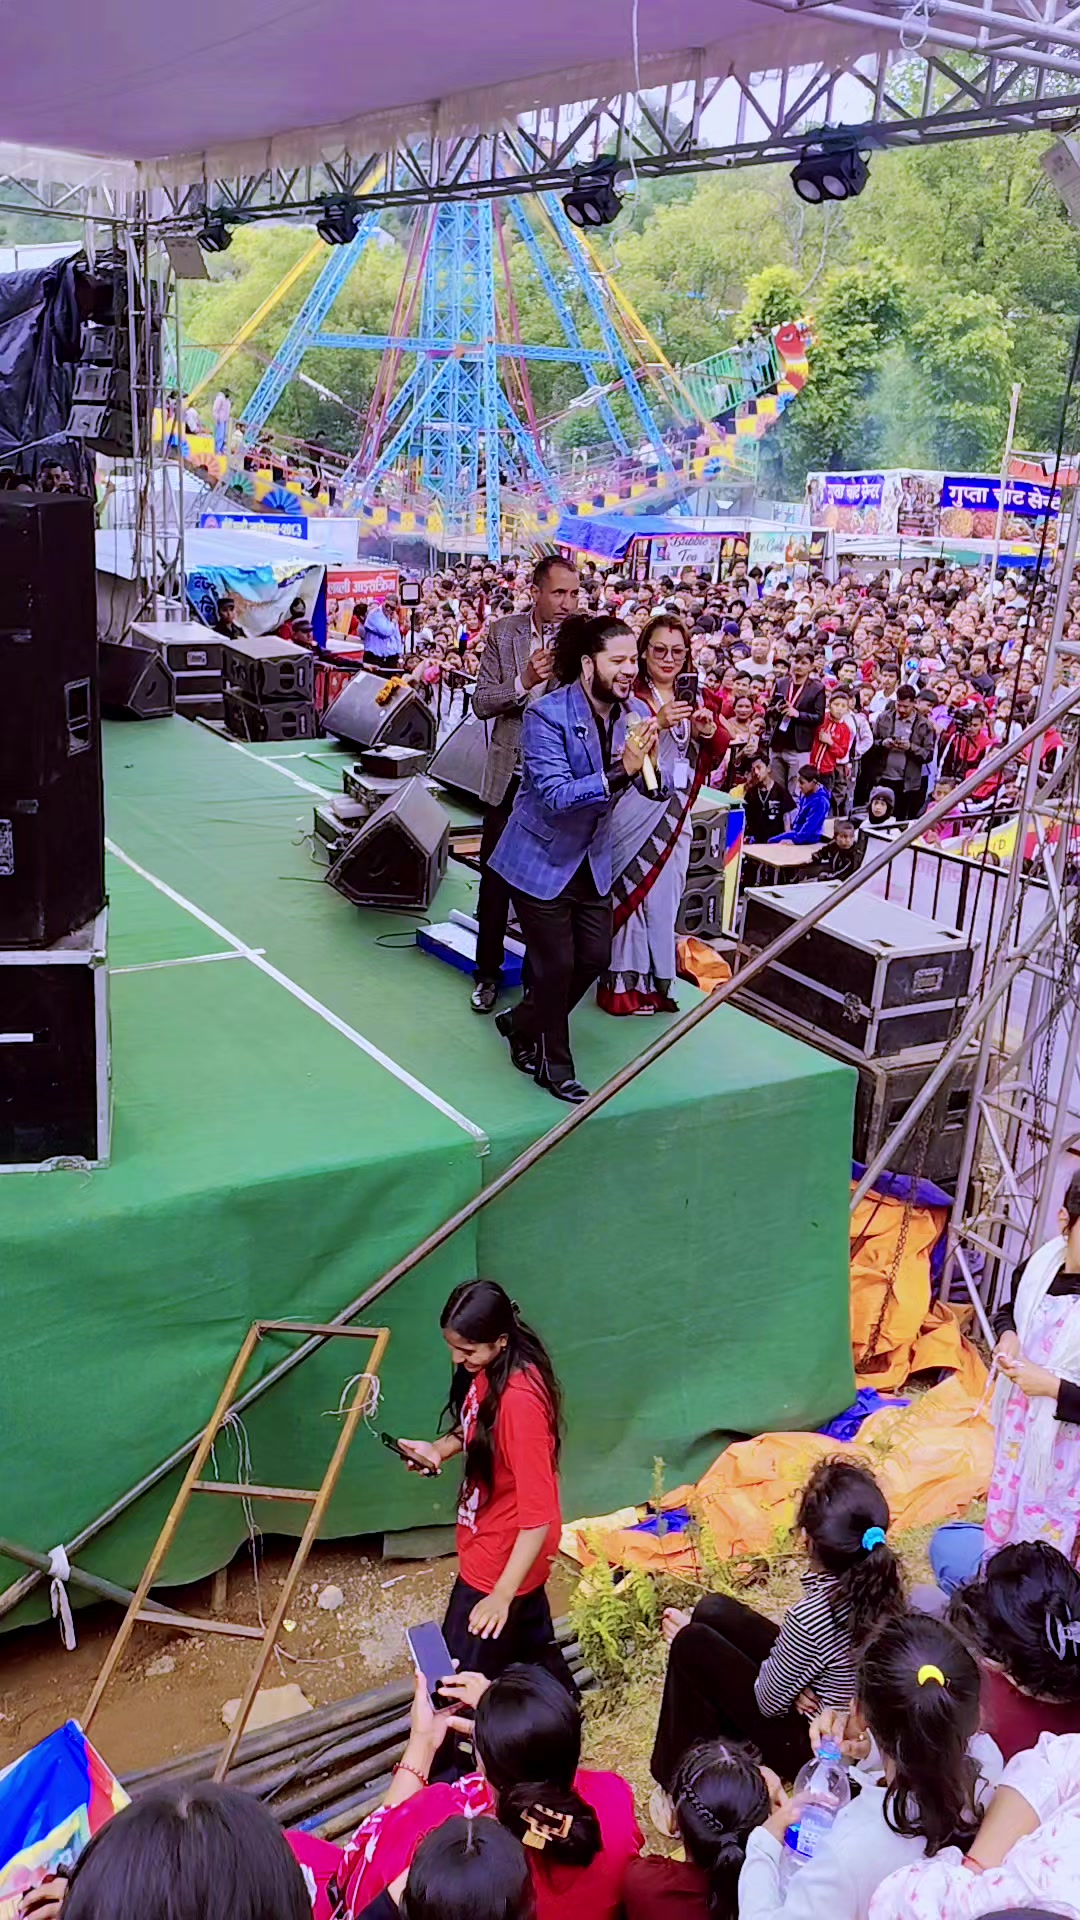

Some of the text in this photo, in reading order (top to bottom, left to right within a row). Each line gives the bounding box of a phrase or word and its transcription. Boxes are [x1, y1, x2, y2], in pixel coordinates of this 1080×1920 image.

[948, 486, 989, 507] गुप्ता
[670, 535, 709, 547] Bubble
[678, 549, 698, 562] Tea
